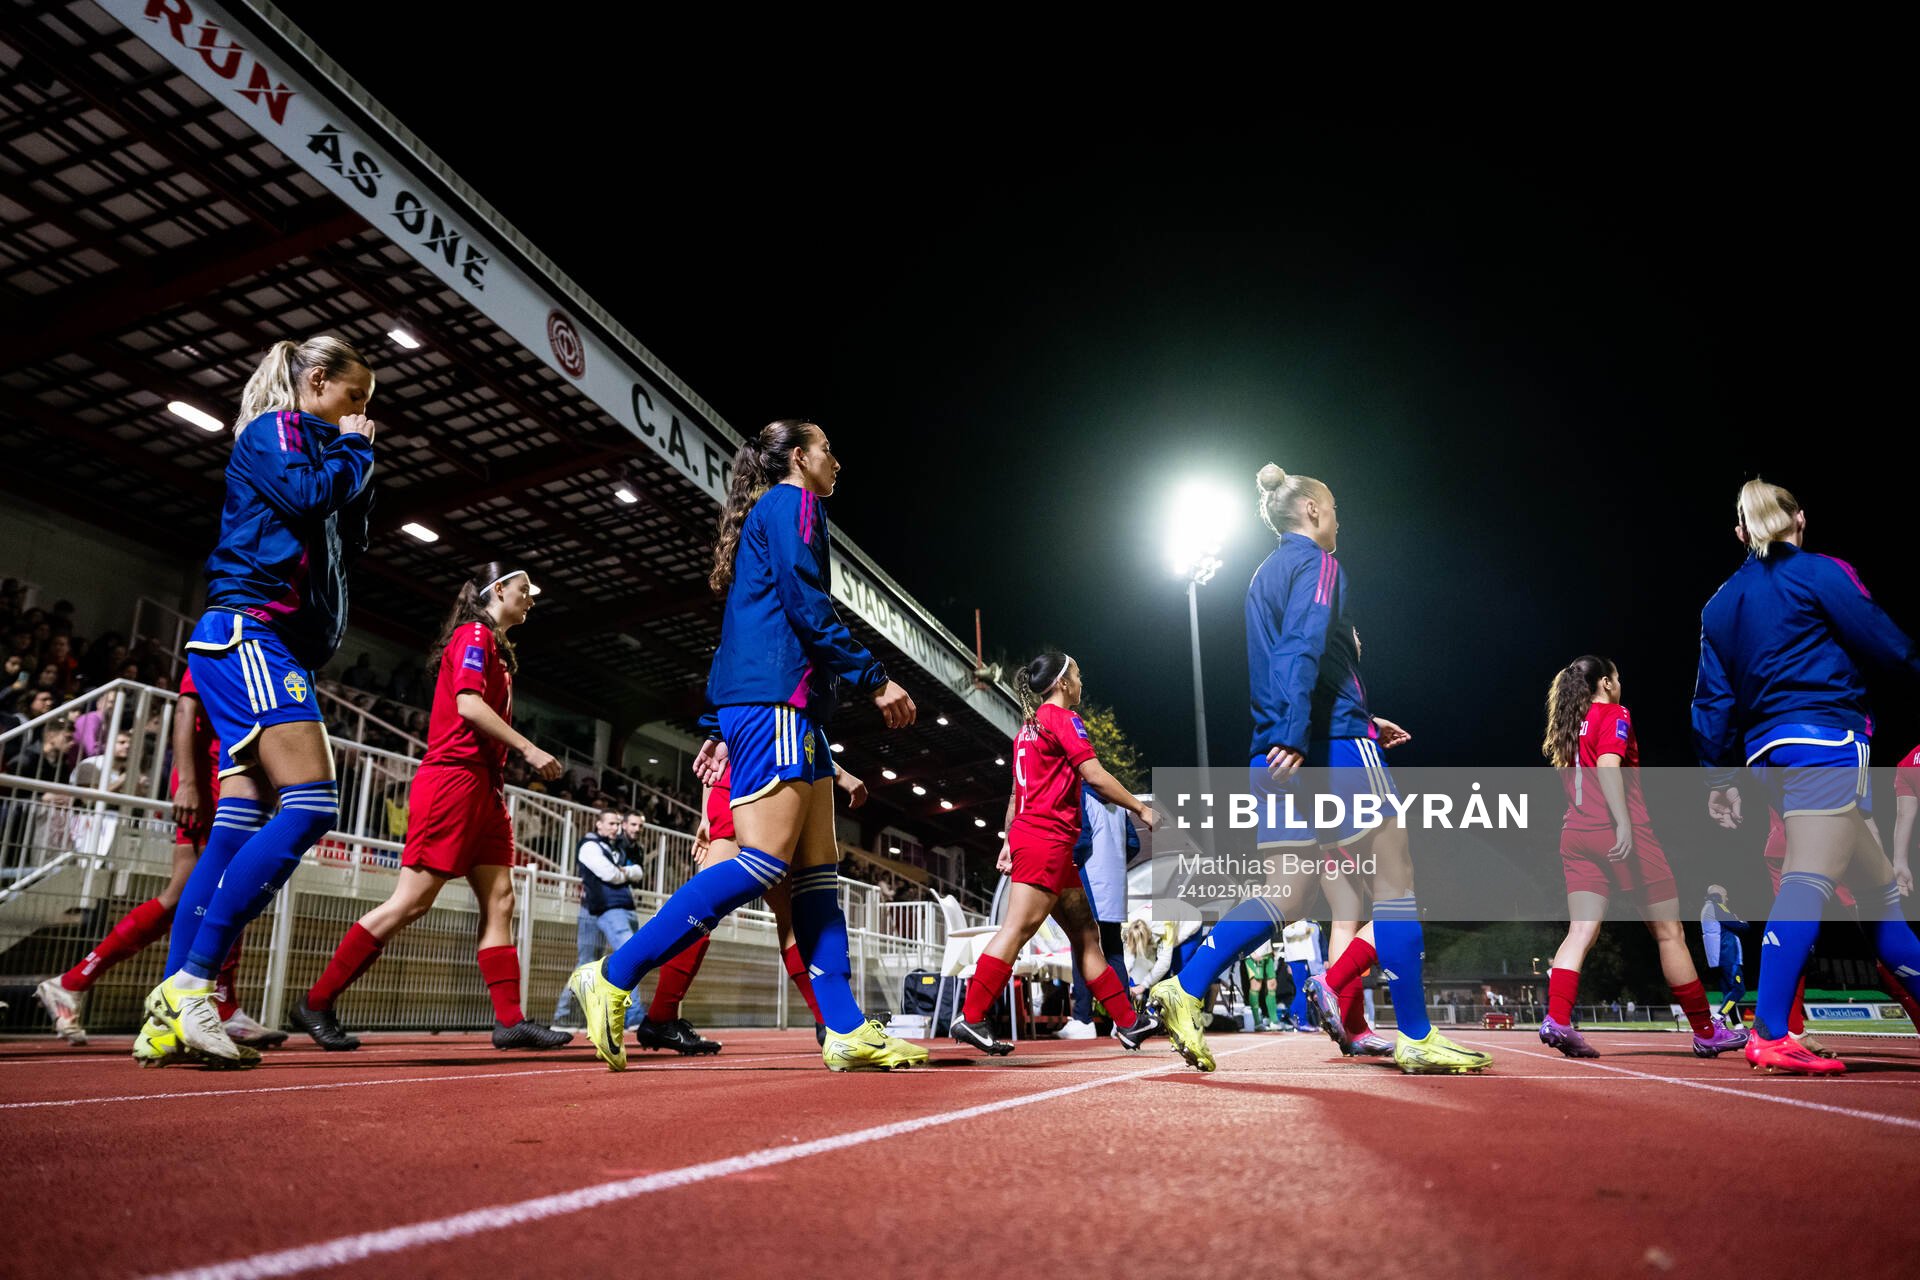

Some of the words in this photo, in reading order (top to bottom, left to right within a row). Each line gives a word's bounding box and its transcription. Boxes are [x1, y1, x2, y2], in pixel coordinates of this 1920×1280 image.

[143, 0, 298, 126] RUN
[306, 123, 383, 199] AS
[388, 190, 489, 292] ONE
[839, 562, 900, 641] STADE
